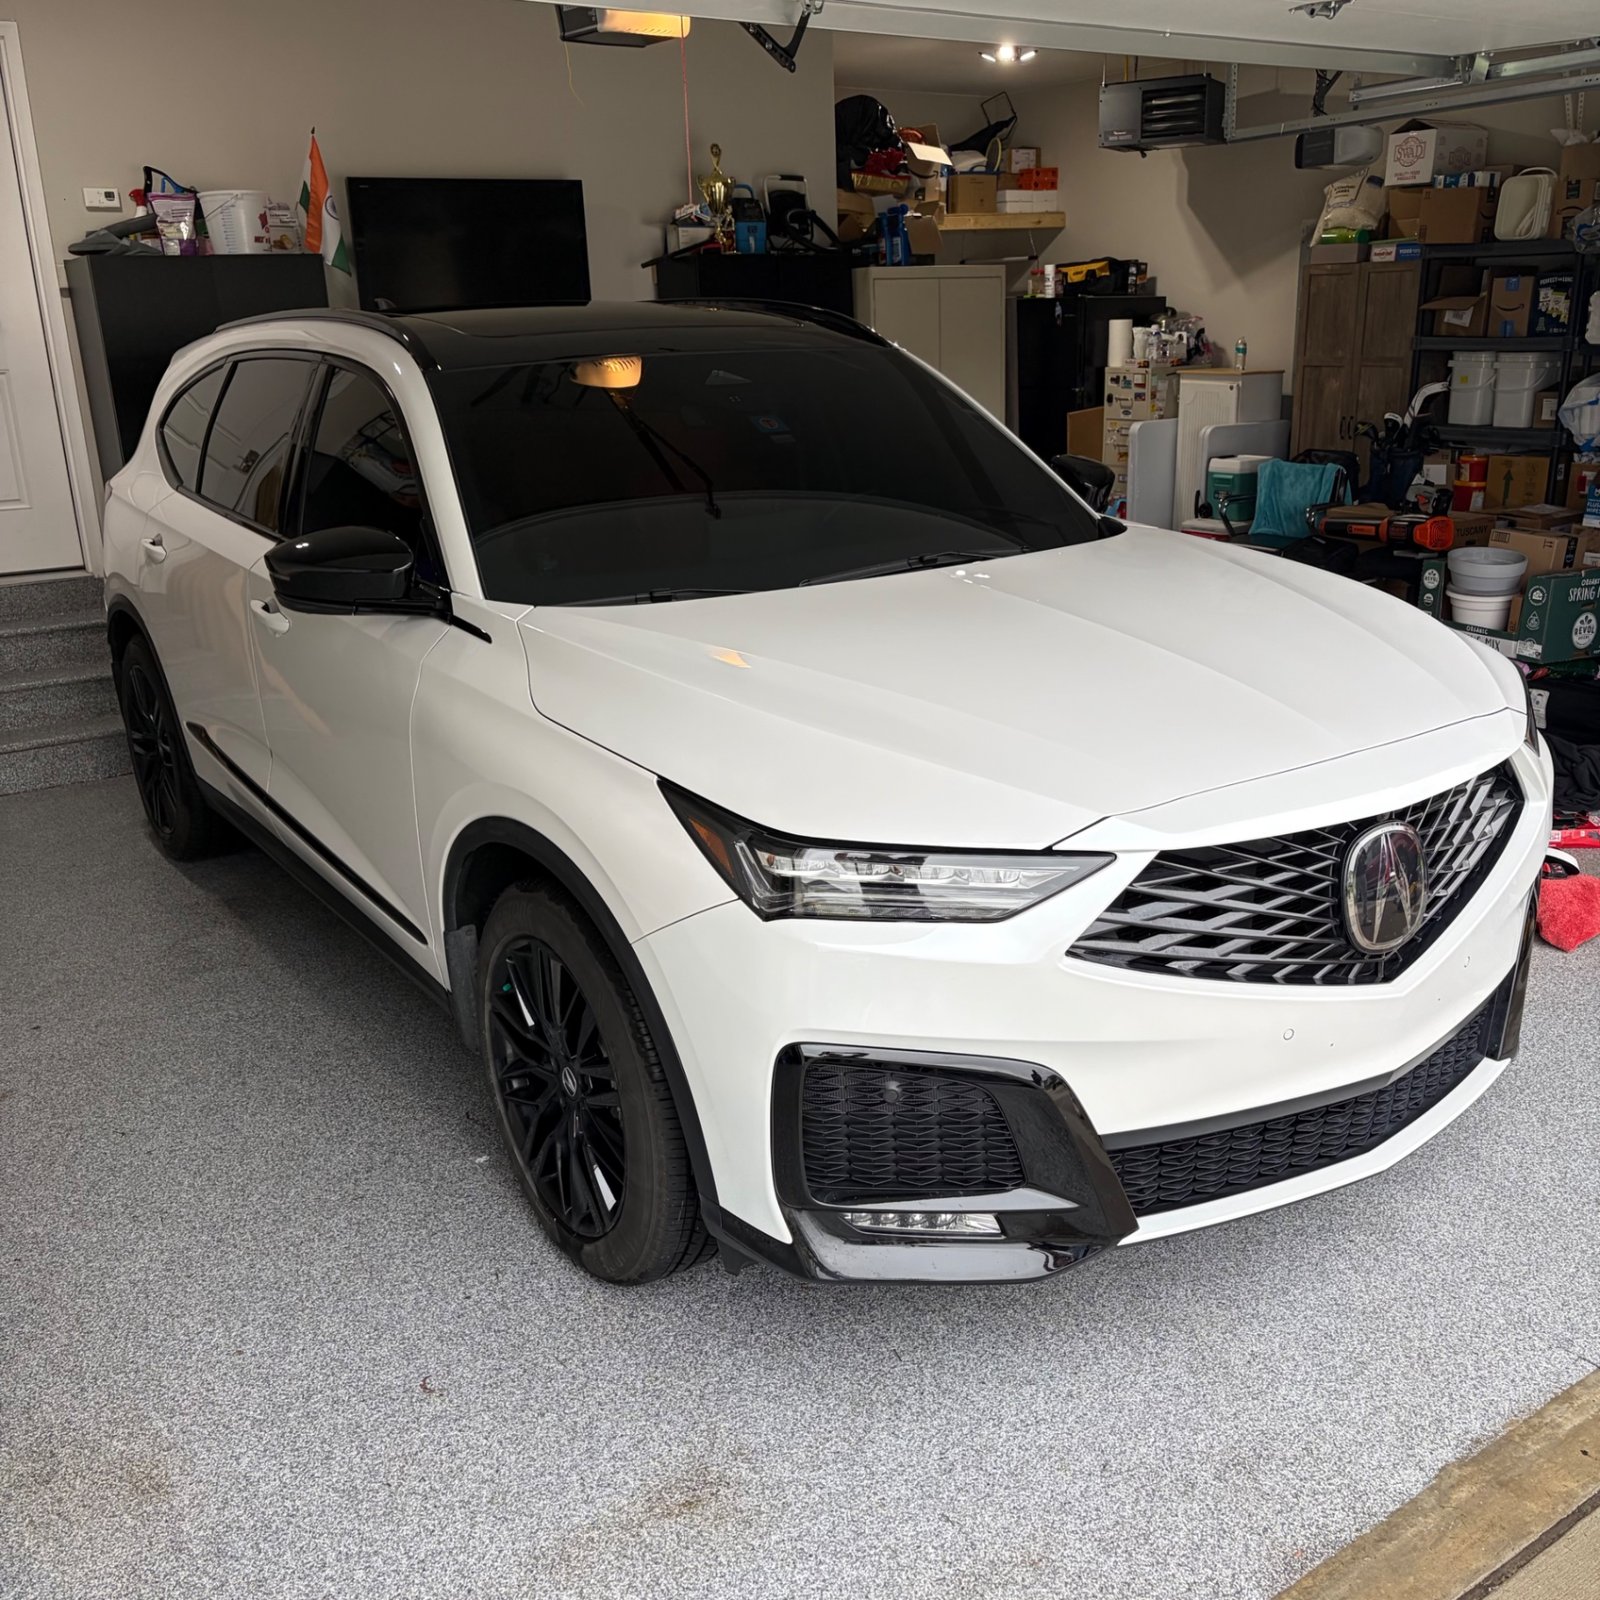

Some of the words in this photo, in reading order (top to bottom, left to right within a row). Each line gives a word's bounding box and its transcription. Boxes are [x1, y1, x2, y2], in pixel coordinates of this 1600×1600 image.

[1456, 524, 1488, 537] TUSCANY
[1568, 586, 1596, 602] SPRING
[1466, 625, 1489, 635] ORGANIC
[1574, 624, 1595, 636] REVOL
[1485, 637, 1501, 652] MIX
